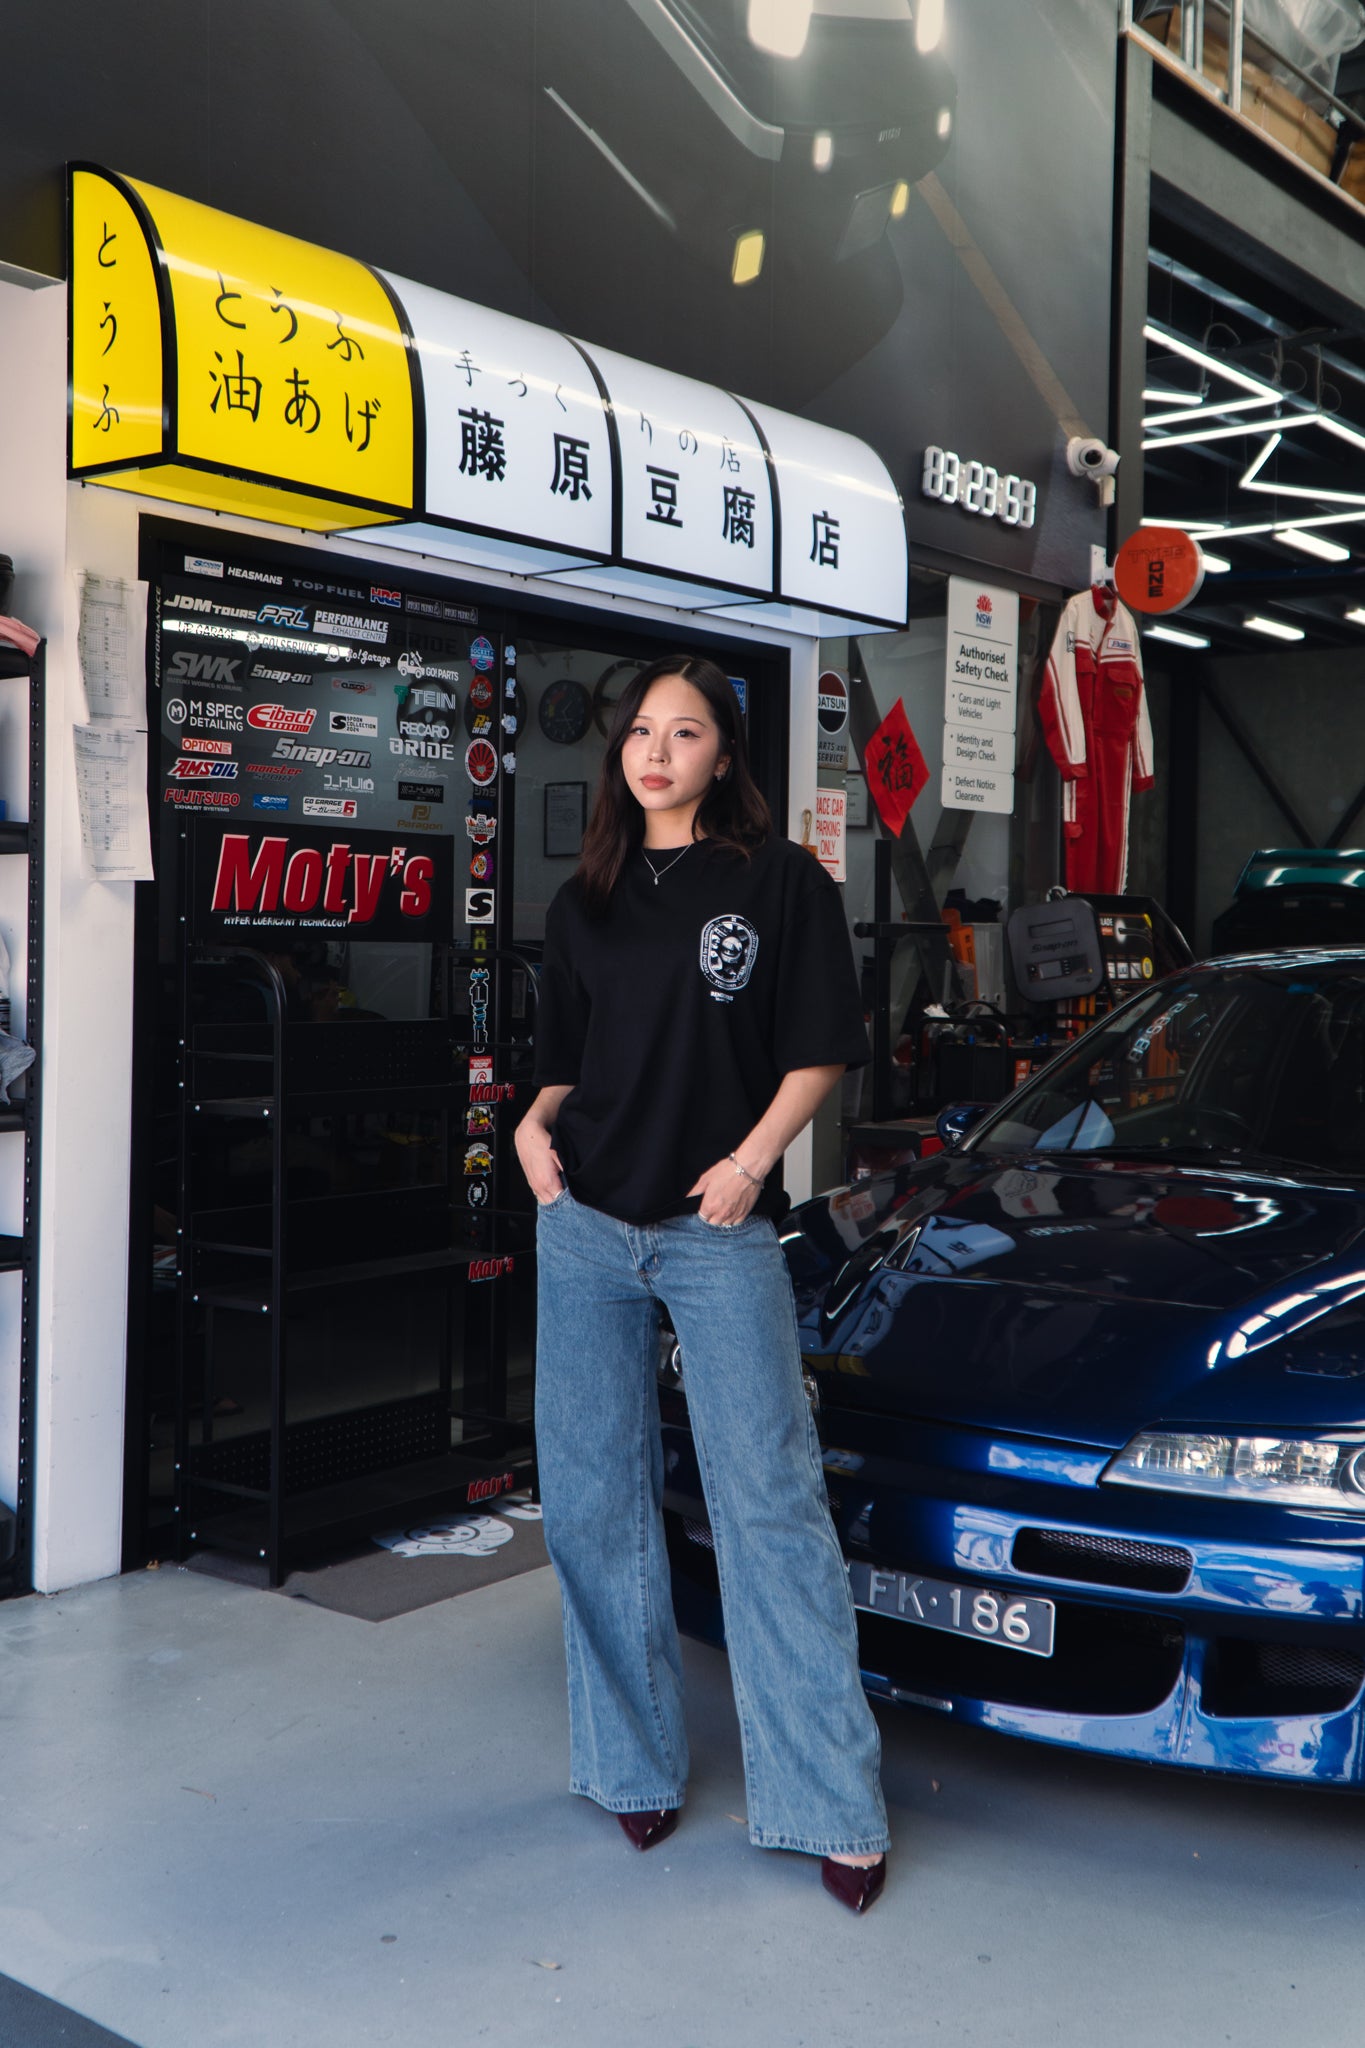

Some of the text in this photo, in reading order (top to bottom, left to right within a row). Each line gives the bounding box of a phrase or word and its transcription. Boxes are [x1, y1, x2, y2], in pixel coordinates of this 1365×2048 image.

[214, 271, 365, 362] とうふ
[93, 222, 119, 432] とうふ
[208, 350, 382, 452] 油あげ
[458, 406, 841, 570] 藤原豆腐店
[227, 566, 283, 585] HEASMANS
[1148, 560, 1164, 598] ONE
[292, 579, 365, 599] TOP FUEL
[371, 587, 401, 608] HRC
[258, 605, 310, 629] PRL
[315, 610, 389, 633] PERFORMANCE
[976, 612, 992, 625] NSW
[332, 626, 385, 641] EXHAUST CENTRE
[279, 640, 319, 656] SERVICE
[960, 644, 1006, 664] Authorised
[167, 651, 243, 683] SWK
[360, 651, 391, 667] Garage
[251, 664, 312, 684] Snap-on
[438, 669, 459, 681] PARTS
[955, 660, 1009, 682] Safety Check
[410, 689, 456, 709] TEIN
[958, 693, 1001, 710] Cars and Light
[190, 700, 243, 720] M SPEC
[248, 704, 315, 733] Eibach
[958, 707, 983, 719] Vehicles
[190, 717, 244, 732] DETAILING
[400, 721, 450, 739] RECARO
[183, 739, 222, 752] OPTION
[389, 737, 455, 761] BRIDE
[818, 742, 835, 751] ARTS
[957, 733, 993, 747] Identity and
[272, 737, 371, 768] Snap-on
[878, 732, 914, 793] 福
[957, 747, 996, 761] Design Check
[171, 759, 237, 778] AMSOIL
[246, 764, 303, 776] monster
[955, 776, 996, 790] Defect Notice
[164, 788, 240, 807] FUJITSUBO
[955, 790, 984, 802] Clearance
[832, 799, 843, 816] CAR
[816, 820, 841, 837] PARKING
[820, 840, 836, 856] ONLY
[211, 833, 434, 924] Moty's
[469, 1083, 515, 1103] Moty's
[468, 1256, 514, 1280] Moty's
[467, 1473, 513, 1501] Moty's
